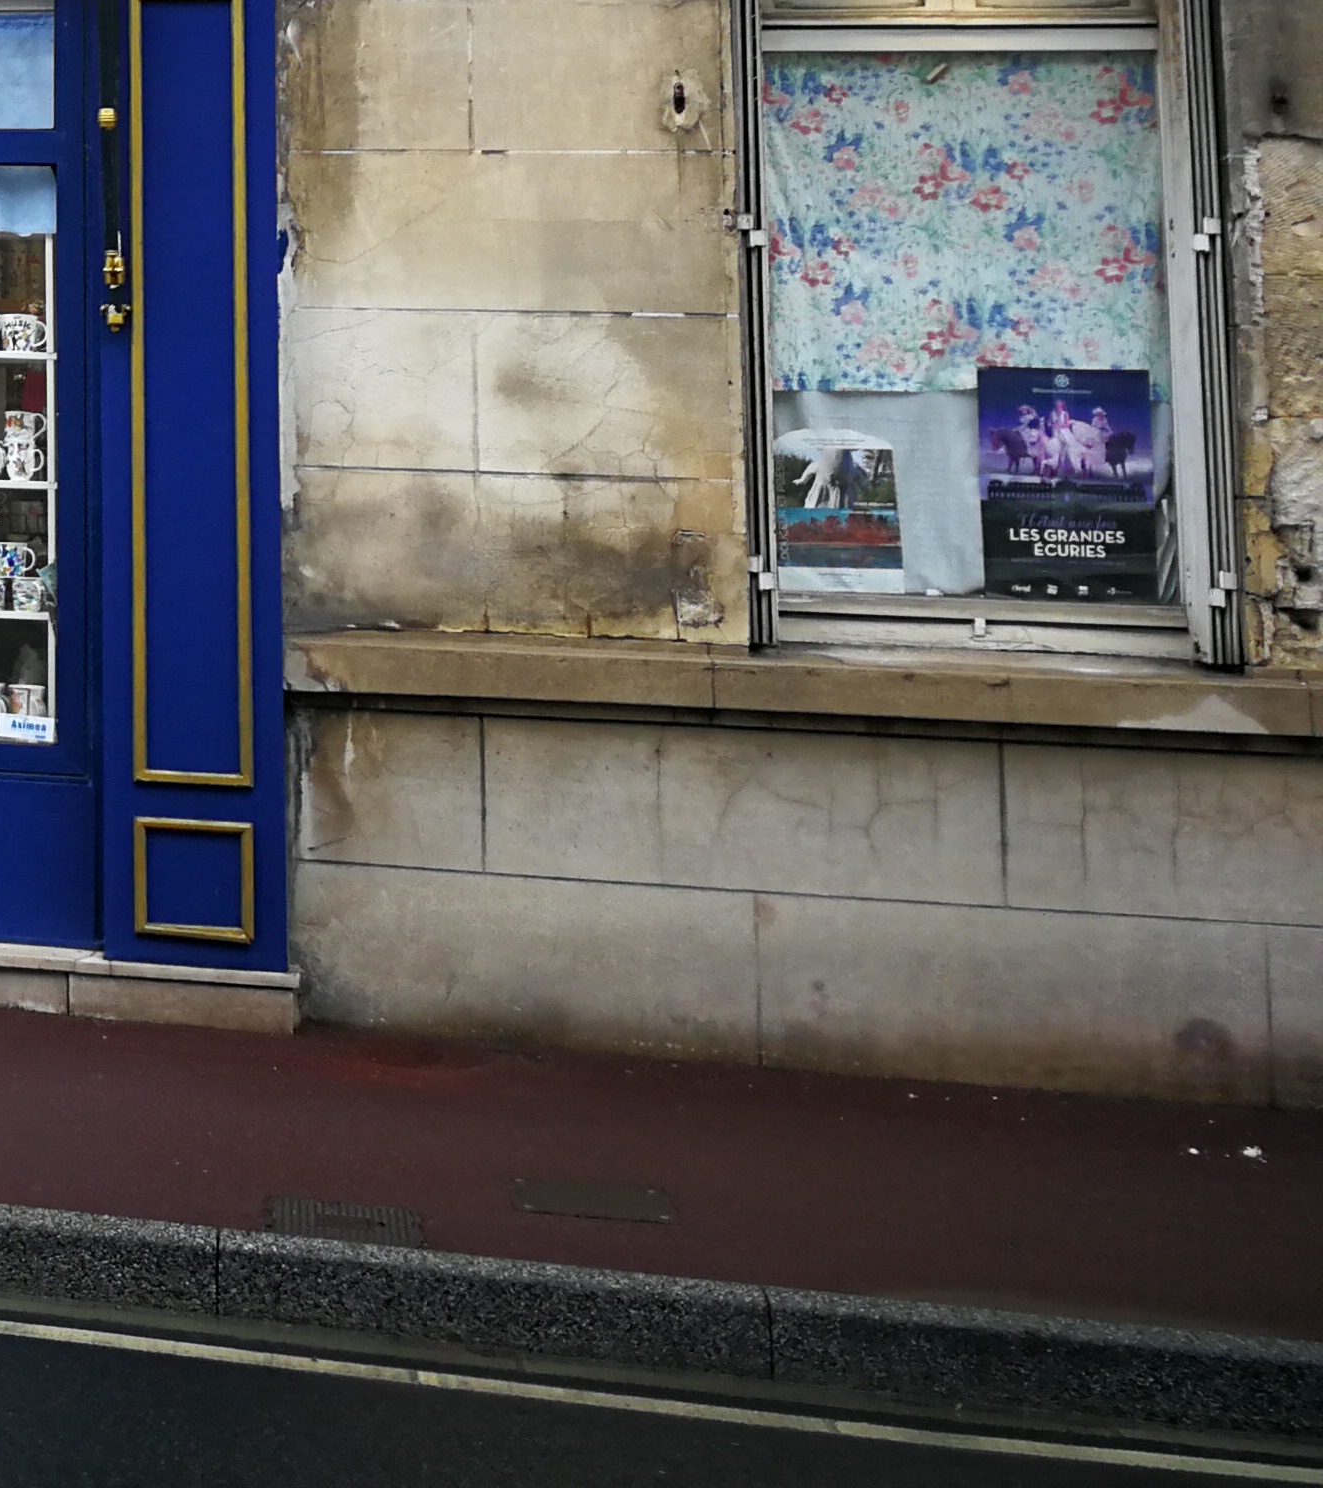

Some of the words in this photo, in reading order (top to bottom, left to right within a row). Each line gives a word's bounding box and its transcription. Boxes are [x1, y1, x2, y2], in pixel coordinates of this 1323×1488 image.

[1009, 528, 1040, 542] LES
[1044, 528, 1126, 544] GRANDES
[1034, 541, 1106, 558] ÉCURIES
